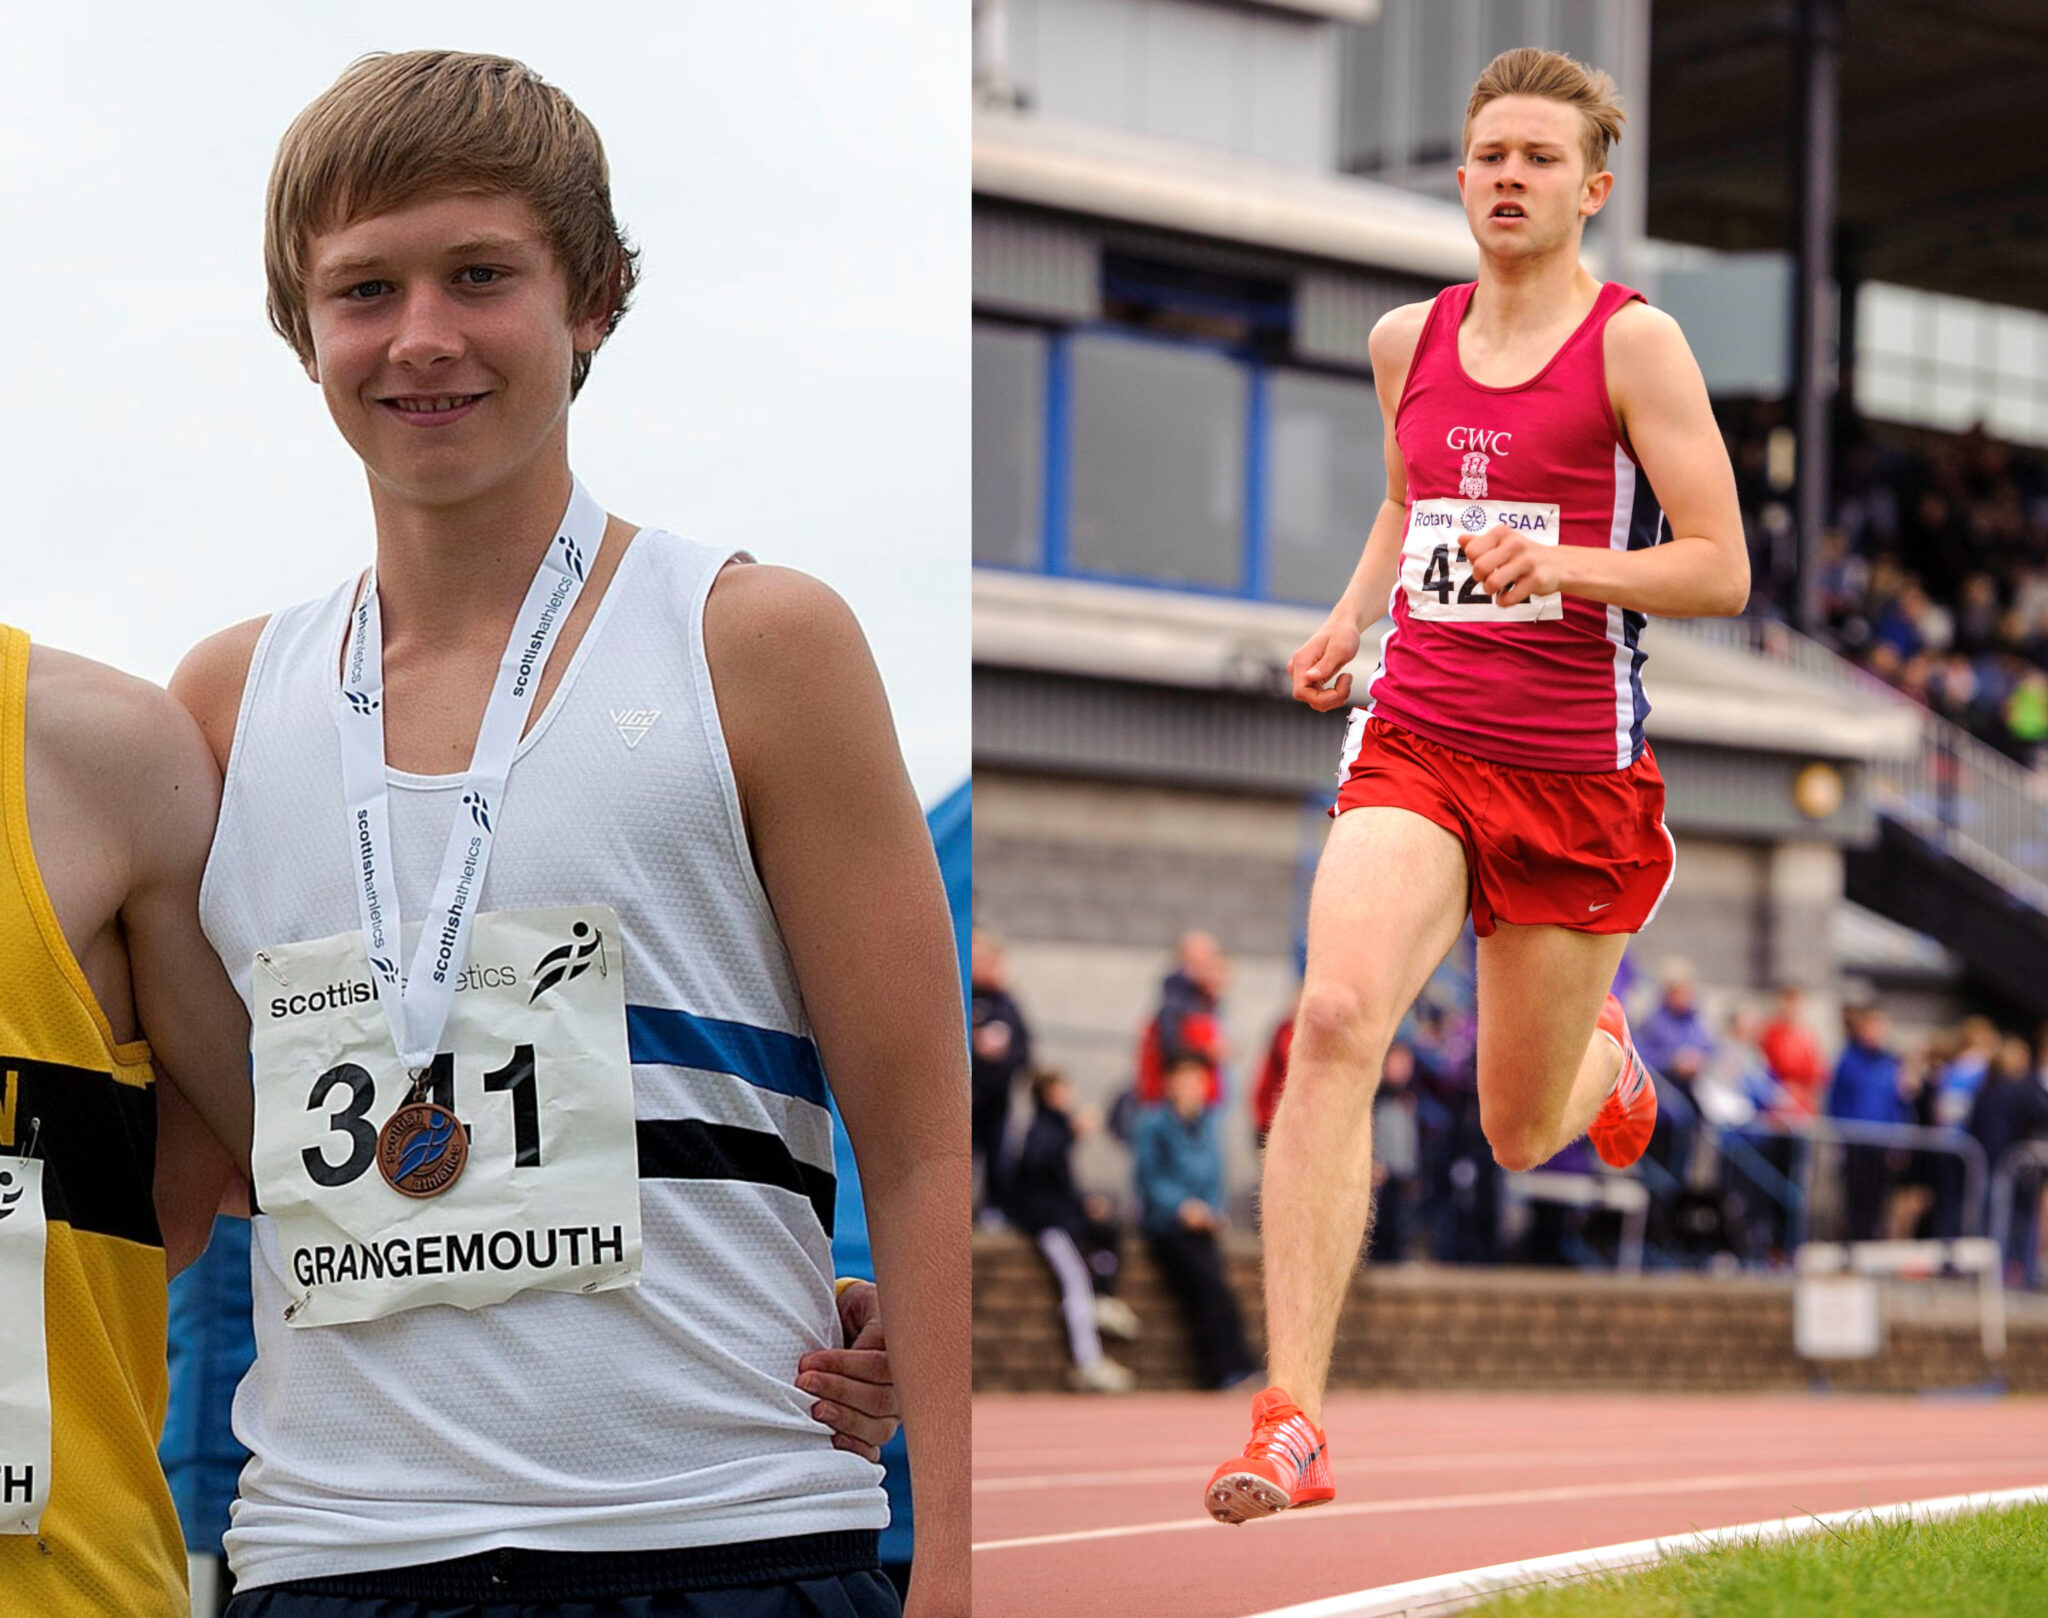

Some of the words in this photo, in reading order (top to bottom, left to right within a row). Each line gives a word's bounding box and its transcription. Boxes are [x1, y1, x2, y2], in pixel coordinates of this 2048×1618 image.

[1446, 426, 1512, 457] GWC
[1414, 511, 1453, 529] Rotary
[1498, 512, 1547, 531] SSAA
[1421, 543, 1531, 605] 42
[293, 1225, 623, 1287] GRANGEMOUTH
